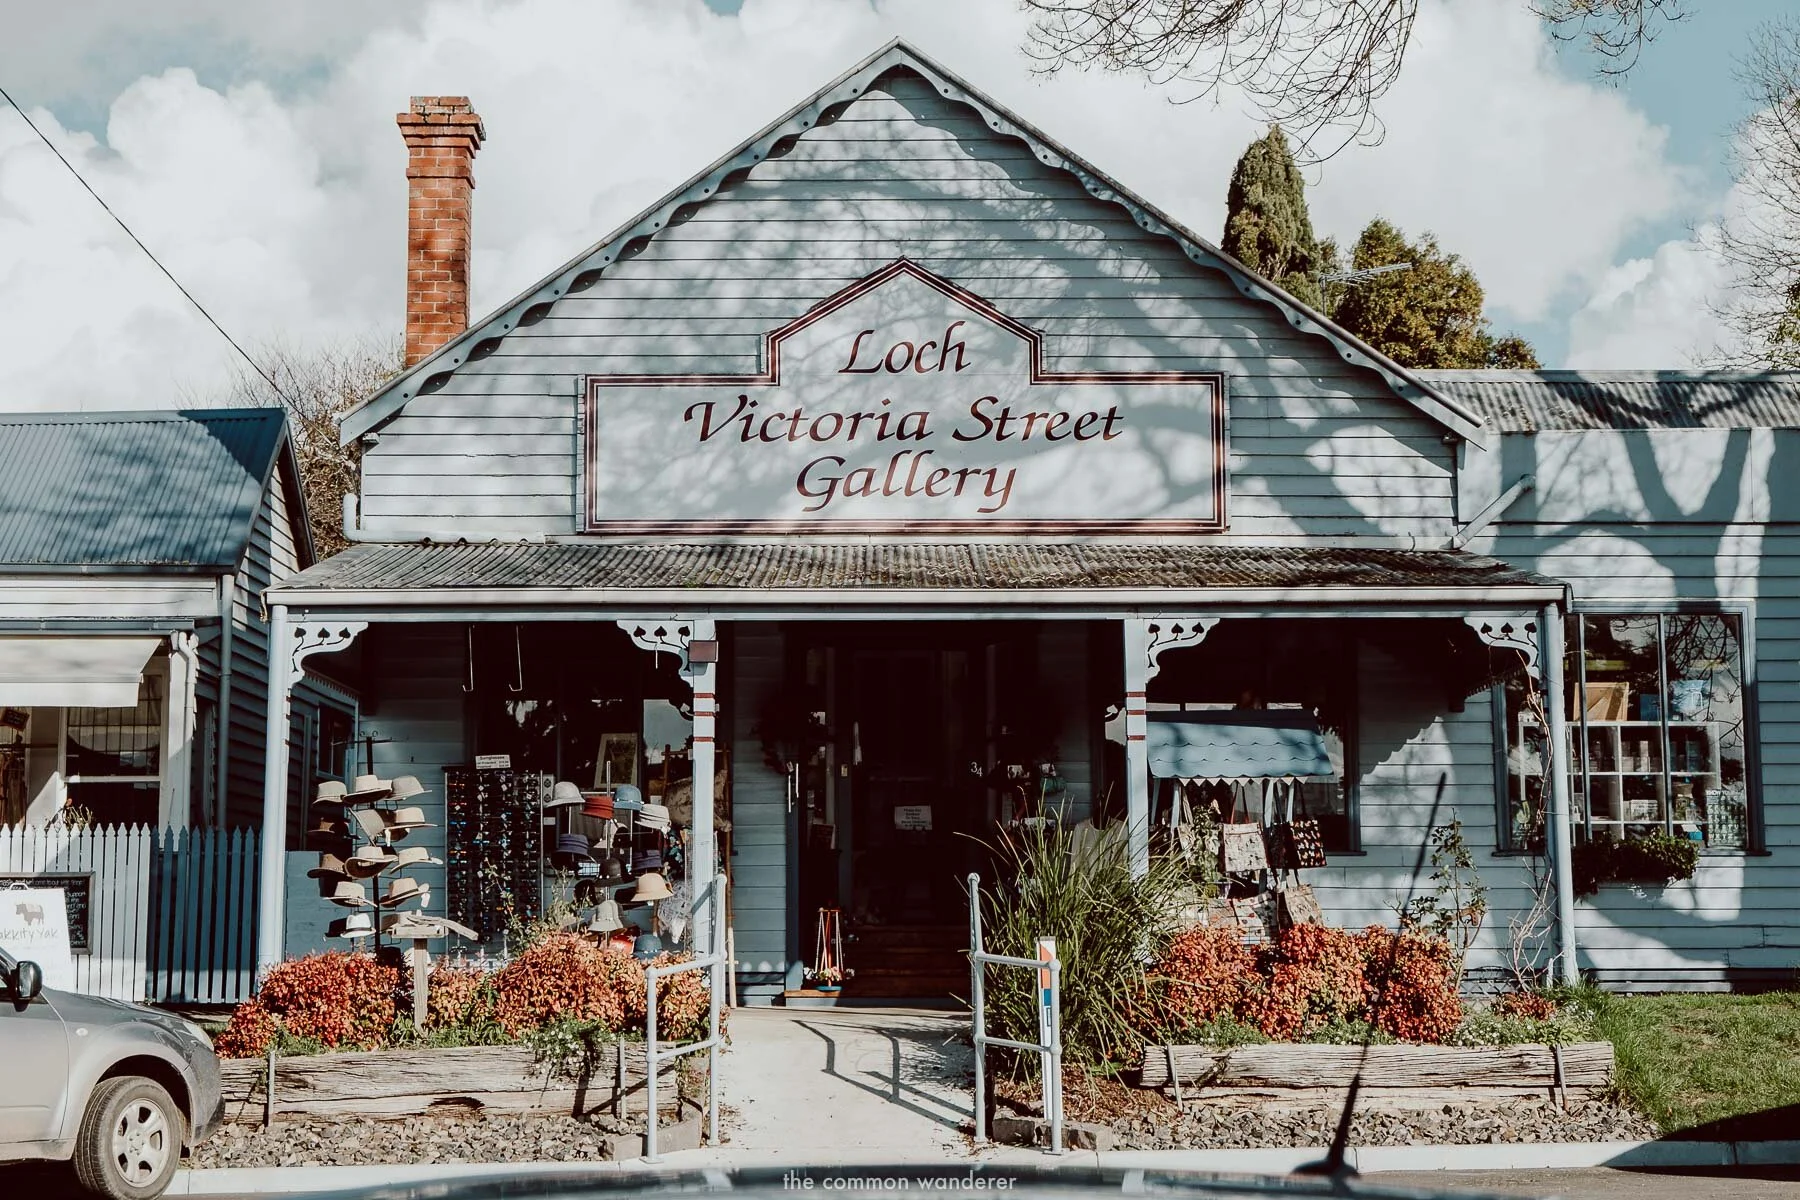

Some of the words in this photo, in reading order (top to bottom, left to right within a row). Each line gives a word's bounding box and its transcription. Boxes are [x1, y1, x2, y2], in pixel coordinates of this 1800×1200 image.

[838, 320, 970, 374] Loch
[684, 394, 934, 443] Victoria
[952, 395, 1123, 442] Street
[796, 449, 1017, 513] Gallery
[970, 761, 983, 777] 34
